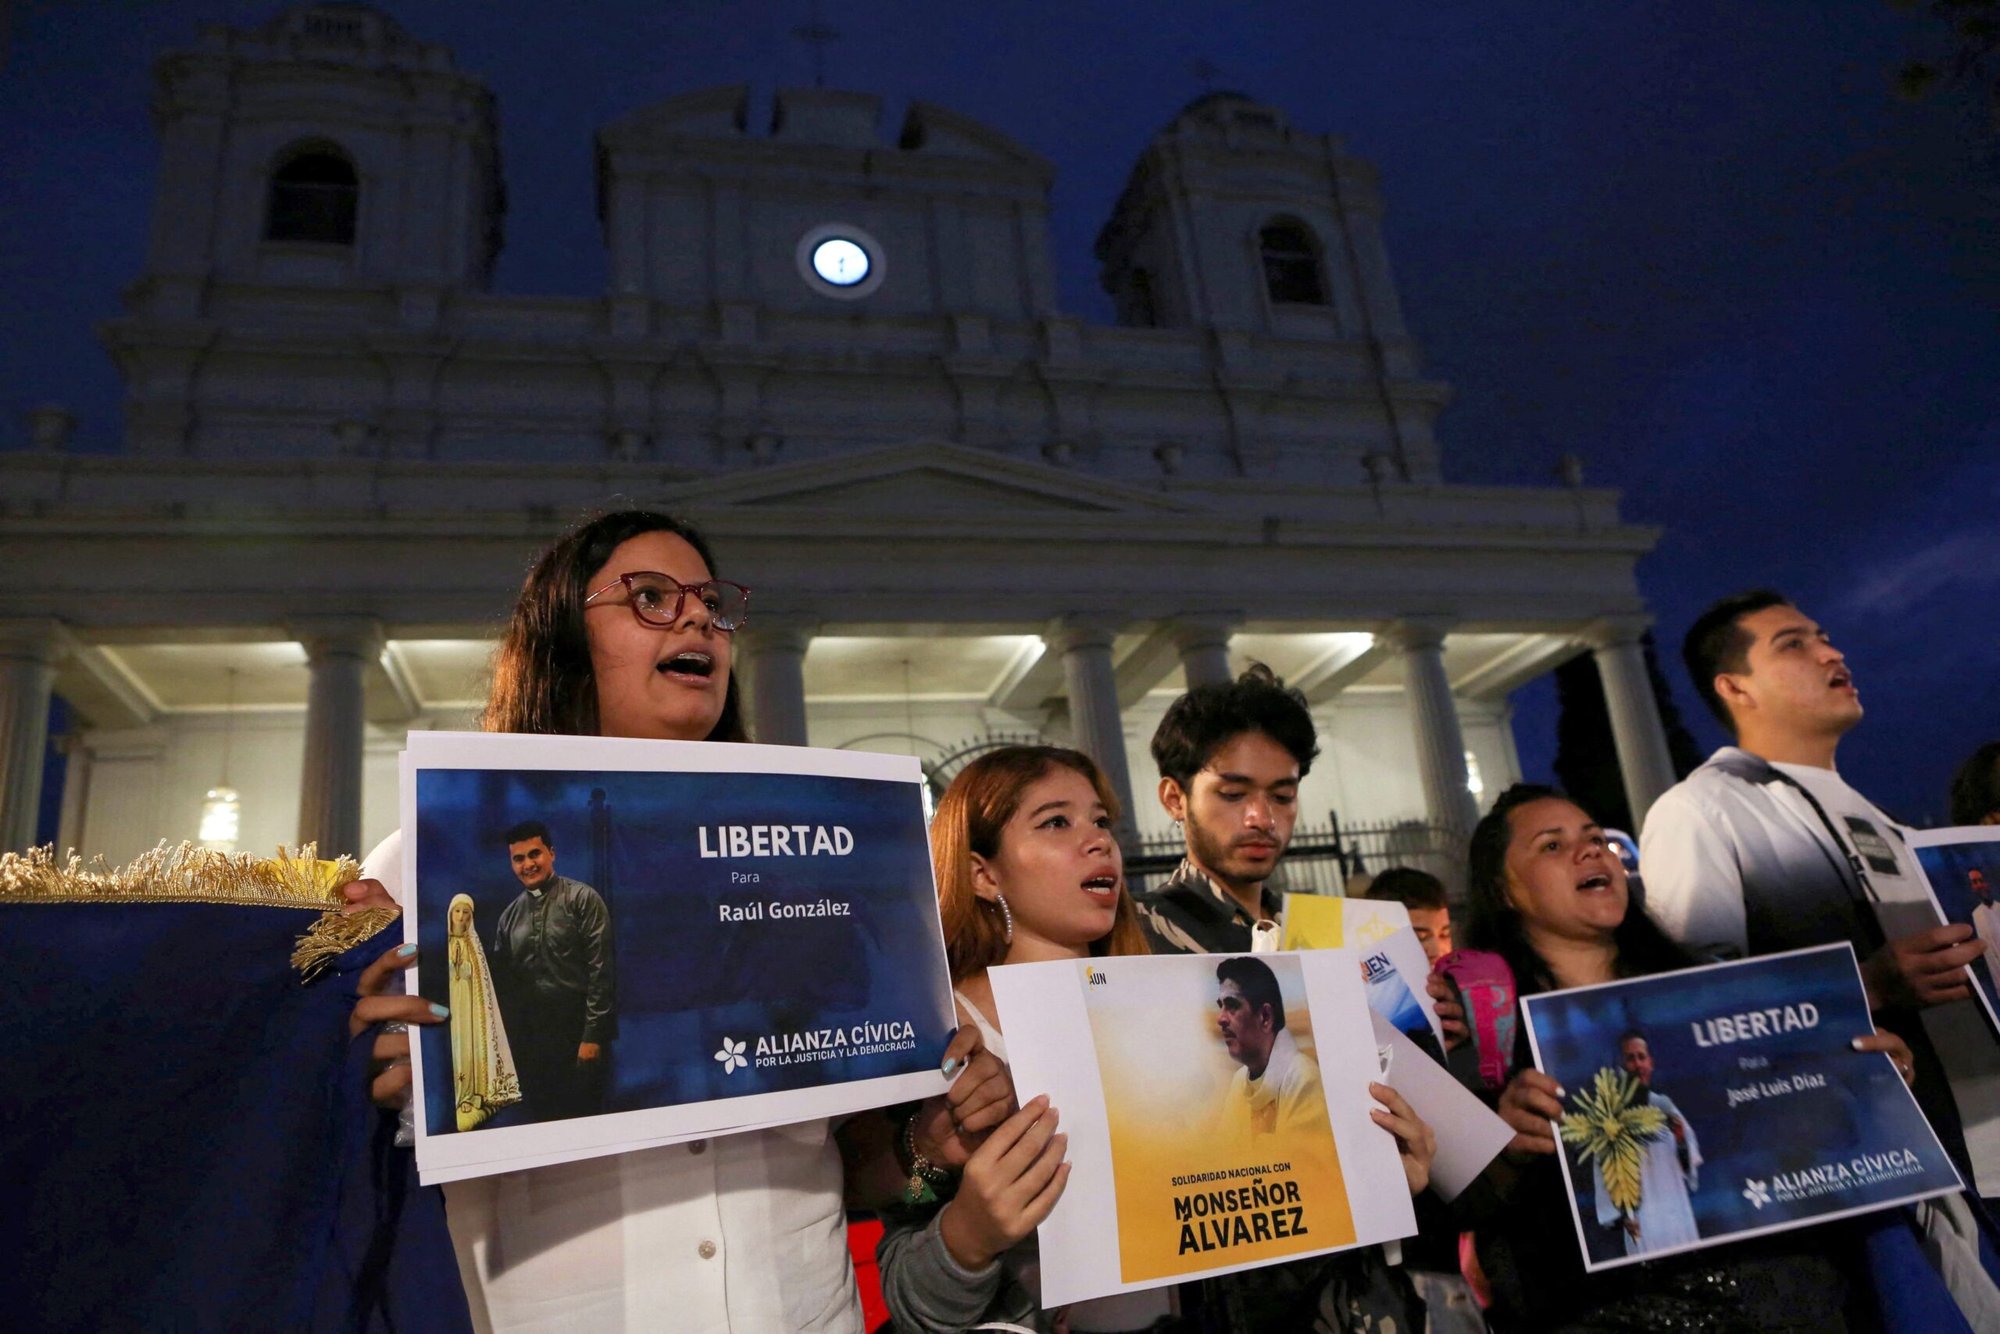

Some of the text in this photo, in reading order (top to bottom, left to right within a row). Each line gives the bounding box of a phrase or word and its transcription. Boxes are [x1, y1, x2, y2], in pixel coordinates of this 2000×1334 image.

[699, 825, 854, 858] LIBERTAD
[731, 872, 760, 884] Para
[719, 899, 851, 922] Raúl González
[1089, 972, 1107, 985] AUN
[755, 1020, 915, 1056] ALIANZA CÍVICA
[1692, 1003, 1819, 1047] LIBERTAD
[755, 1040, 916, 1068] POR LA JUSTICIA Y LA DEMOCRACIA
[1727, 1072, 1827, 1107] José Luis Díaz
[1171, 1162, 1291, 1187] SOLIDARIDAD NACIONAL CON
[1773, 1148, 1920, 1192] ALIANZA CÍVICA
[1174, 1178, 1301, 1221] MONSEÑOR
[1179, 1206, 1308, 1255] ÁLVAREZ
